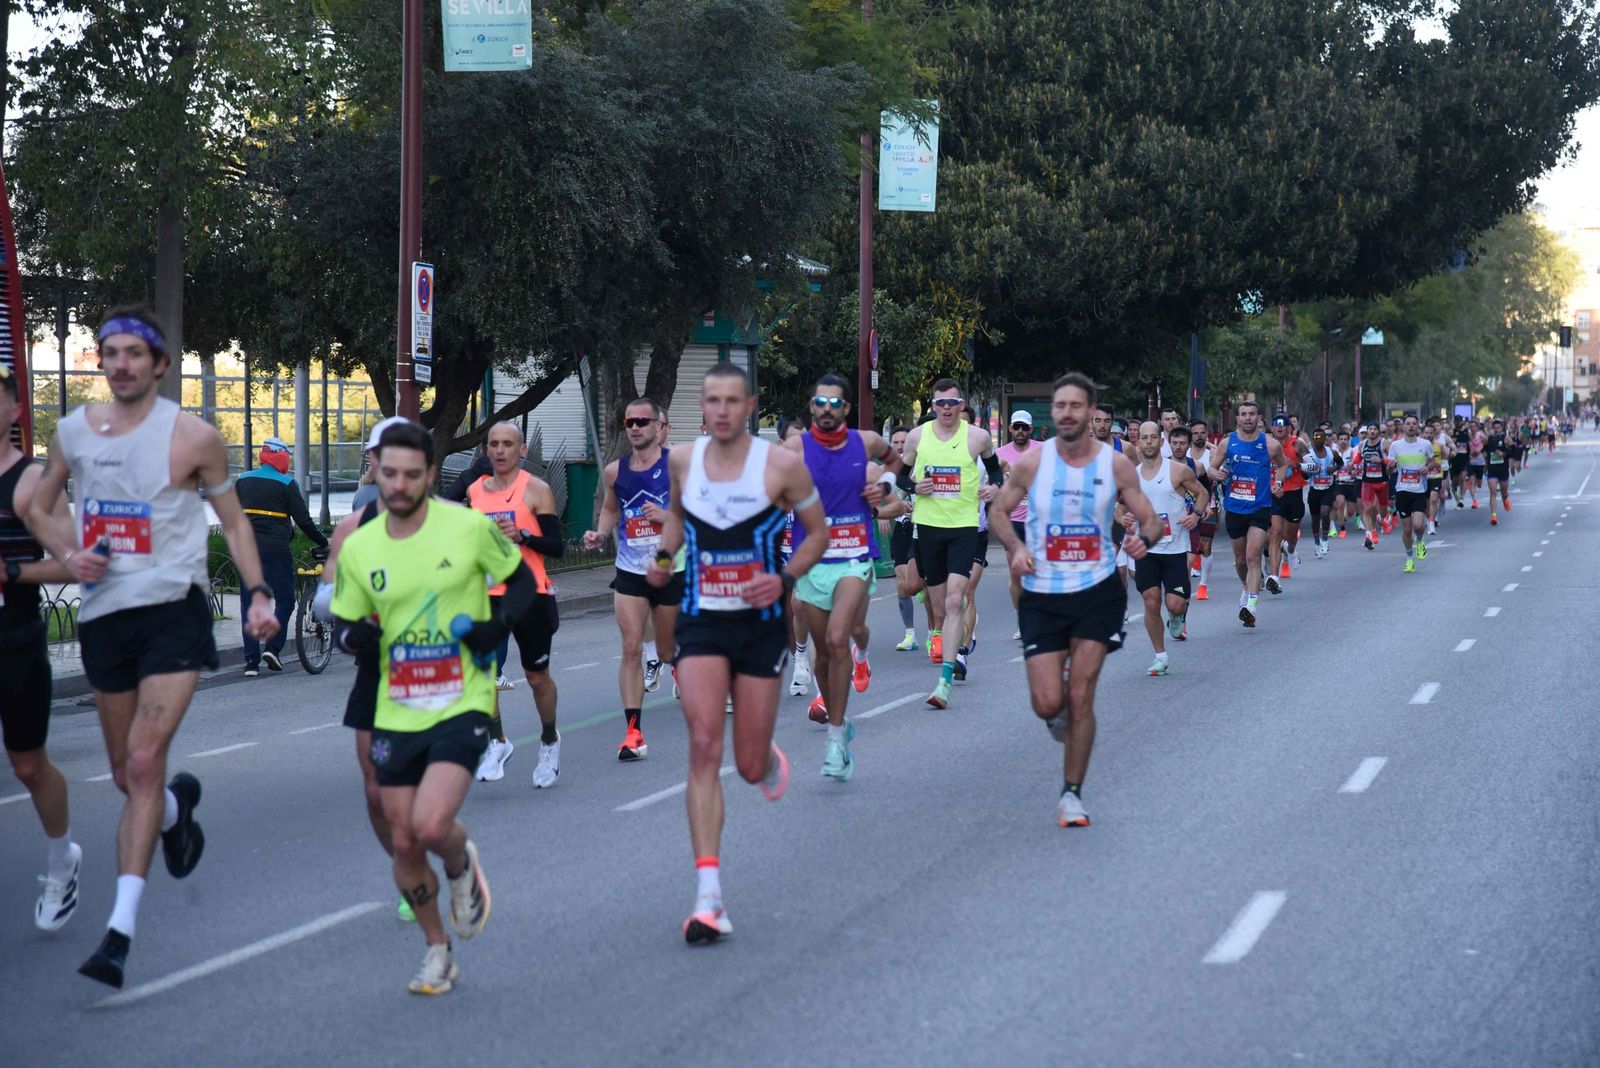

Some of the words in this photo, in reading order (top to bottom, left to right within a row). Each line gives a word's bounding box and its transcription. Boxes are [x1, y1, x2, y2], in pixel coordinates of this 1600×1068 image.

[448, 0, 528, 15] SEVILLA
[103, 503, 143, 515] ZURICH
[835, 515, 862, 524] ZURICH
[635, 527, 657, 537] CARL
[1063, 526, 1096, 535] ZURICH
[716, 551, 754, 564] ZURICH
[1060, 550, 1087, 561] SATO
[409, 646, 452, 659] ZURICH
